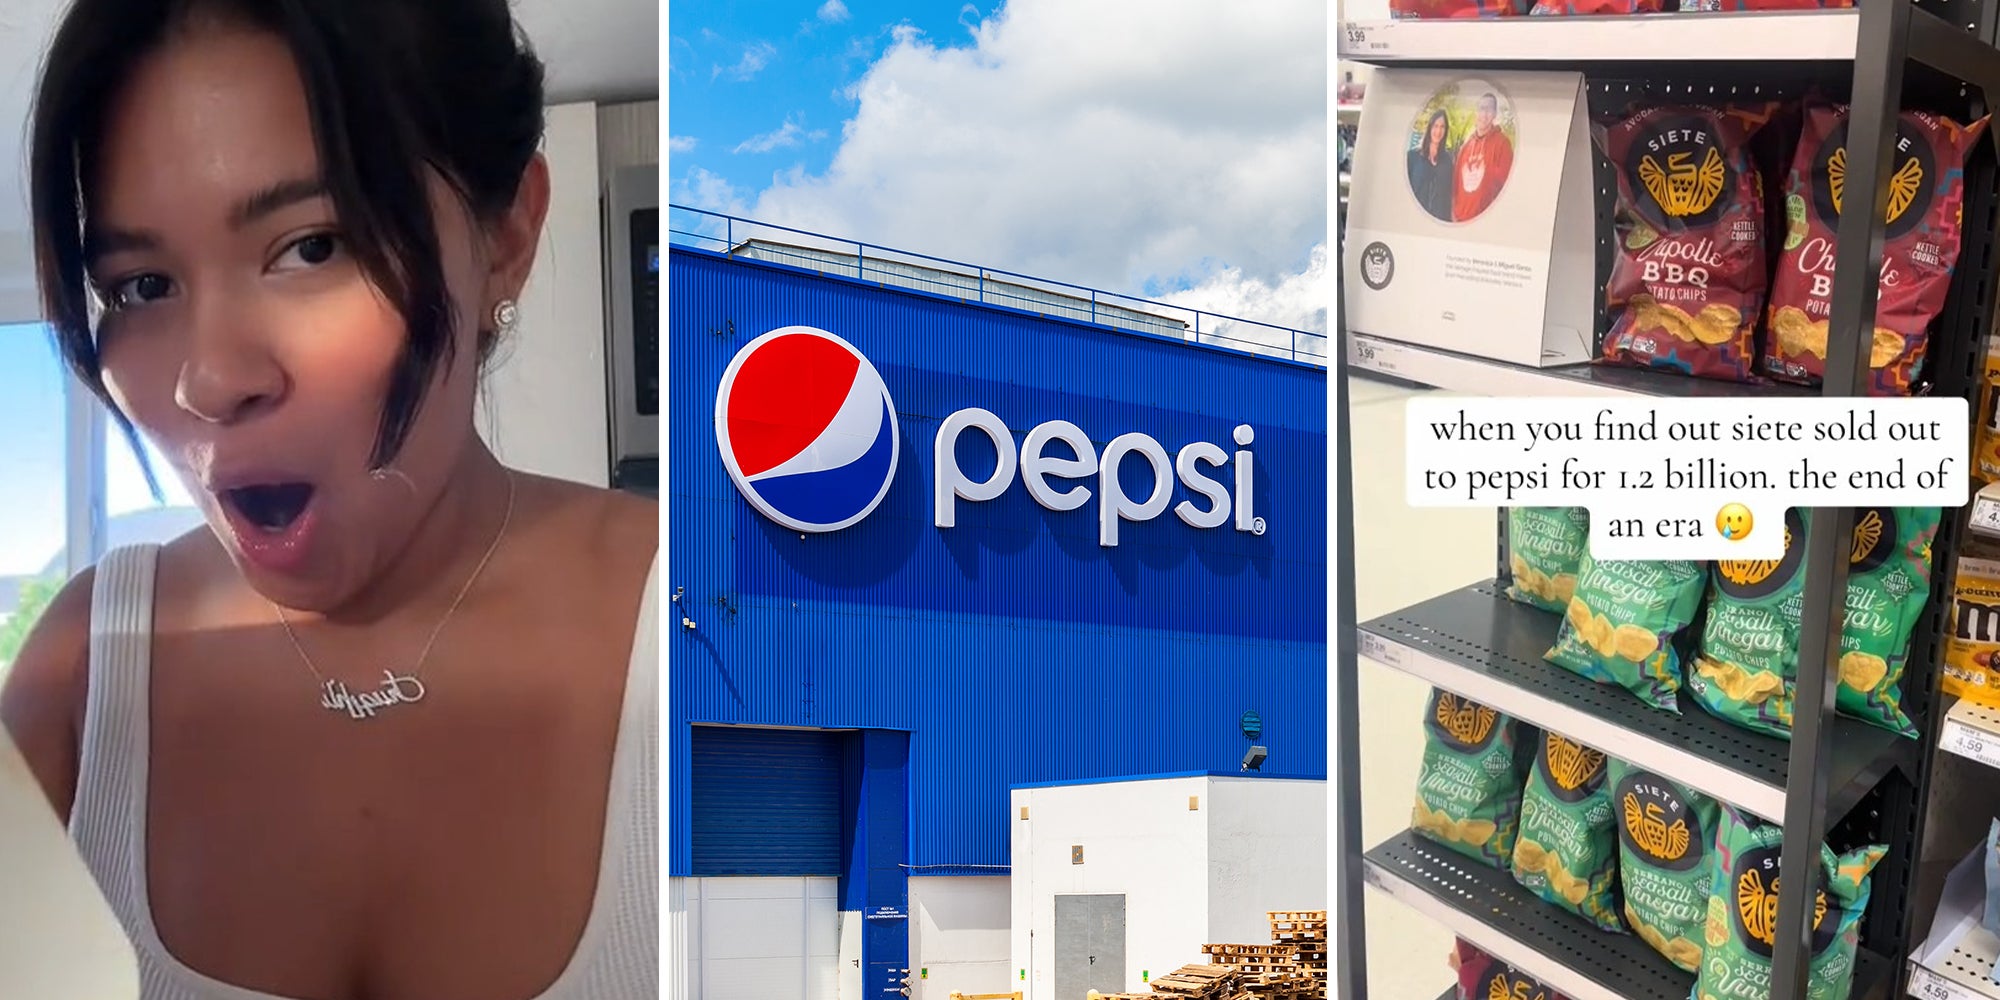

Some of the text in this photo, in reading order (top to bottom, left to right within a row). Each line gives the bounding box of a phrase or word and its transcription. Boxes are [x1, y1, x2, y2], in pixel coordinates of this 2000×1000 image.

[1347, 30, 1366, 43] 3.99
[1648, 129, 1707, 154] SIETE
[1641, 261, 1709, 289] BBQ
[1679, 288, 1707, 301] CHIPS
[1358, 347, 1375, 360] 3.99
[935, 407, 1254, 546] pepsi
[1744, 655, 1770, 669] CHIPS
[1956, 736, 1984, 753] 4.59
[1635, 784, 1680, 813] SIETE
[1660, 919, 1685, 937] CHIPS
